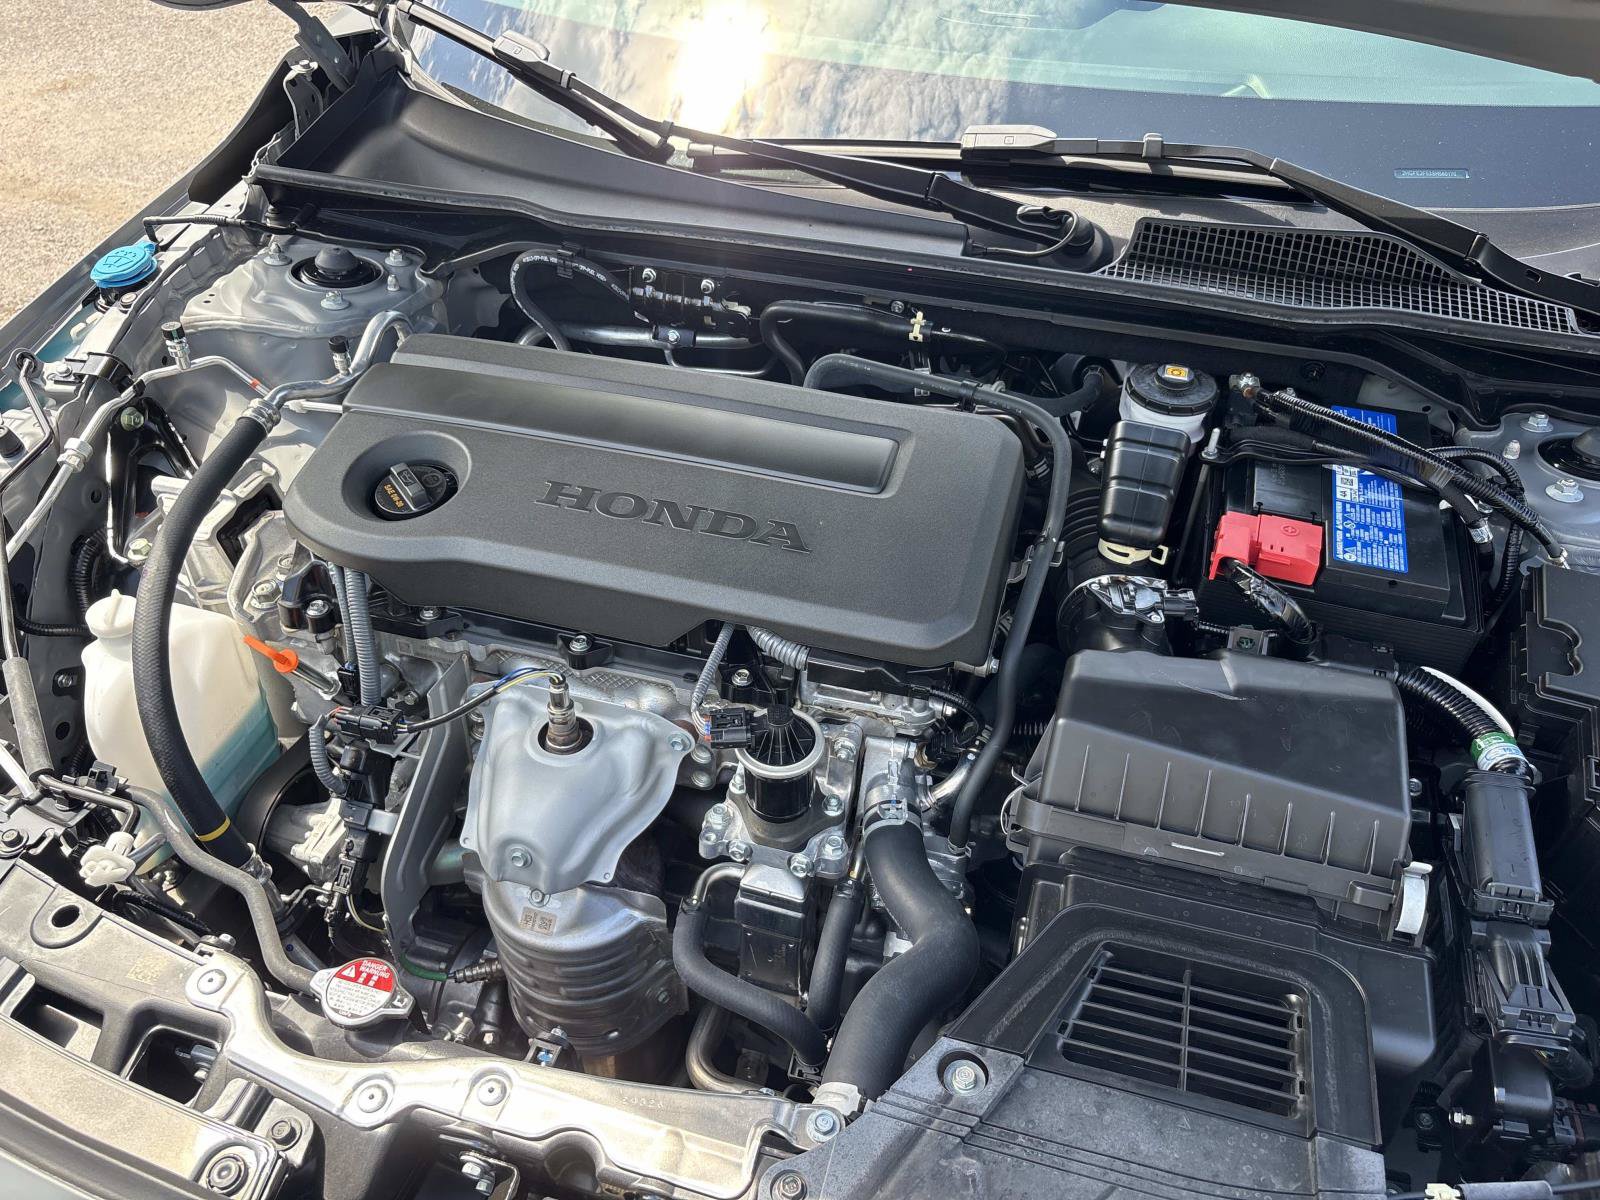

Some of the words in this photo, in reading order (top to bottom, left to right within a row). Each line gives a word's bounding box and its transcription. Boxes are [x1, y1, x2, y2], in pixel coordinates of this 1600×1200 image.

[384, 484, 396, 495] SAE
[533, 480, 811, 554] HONDA
[362, 960, 387, 971] DANGER
[360, 966, 390, 978] WARNING
